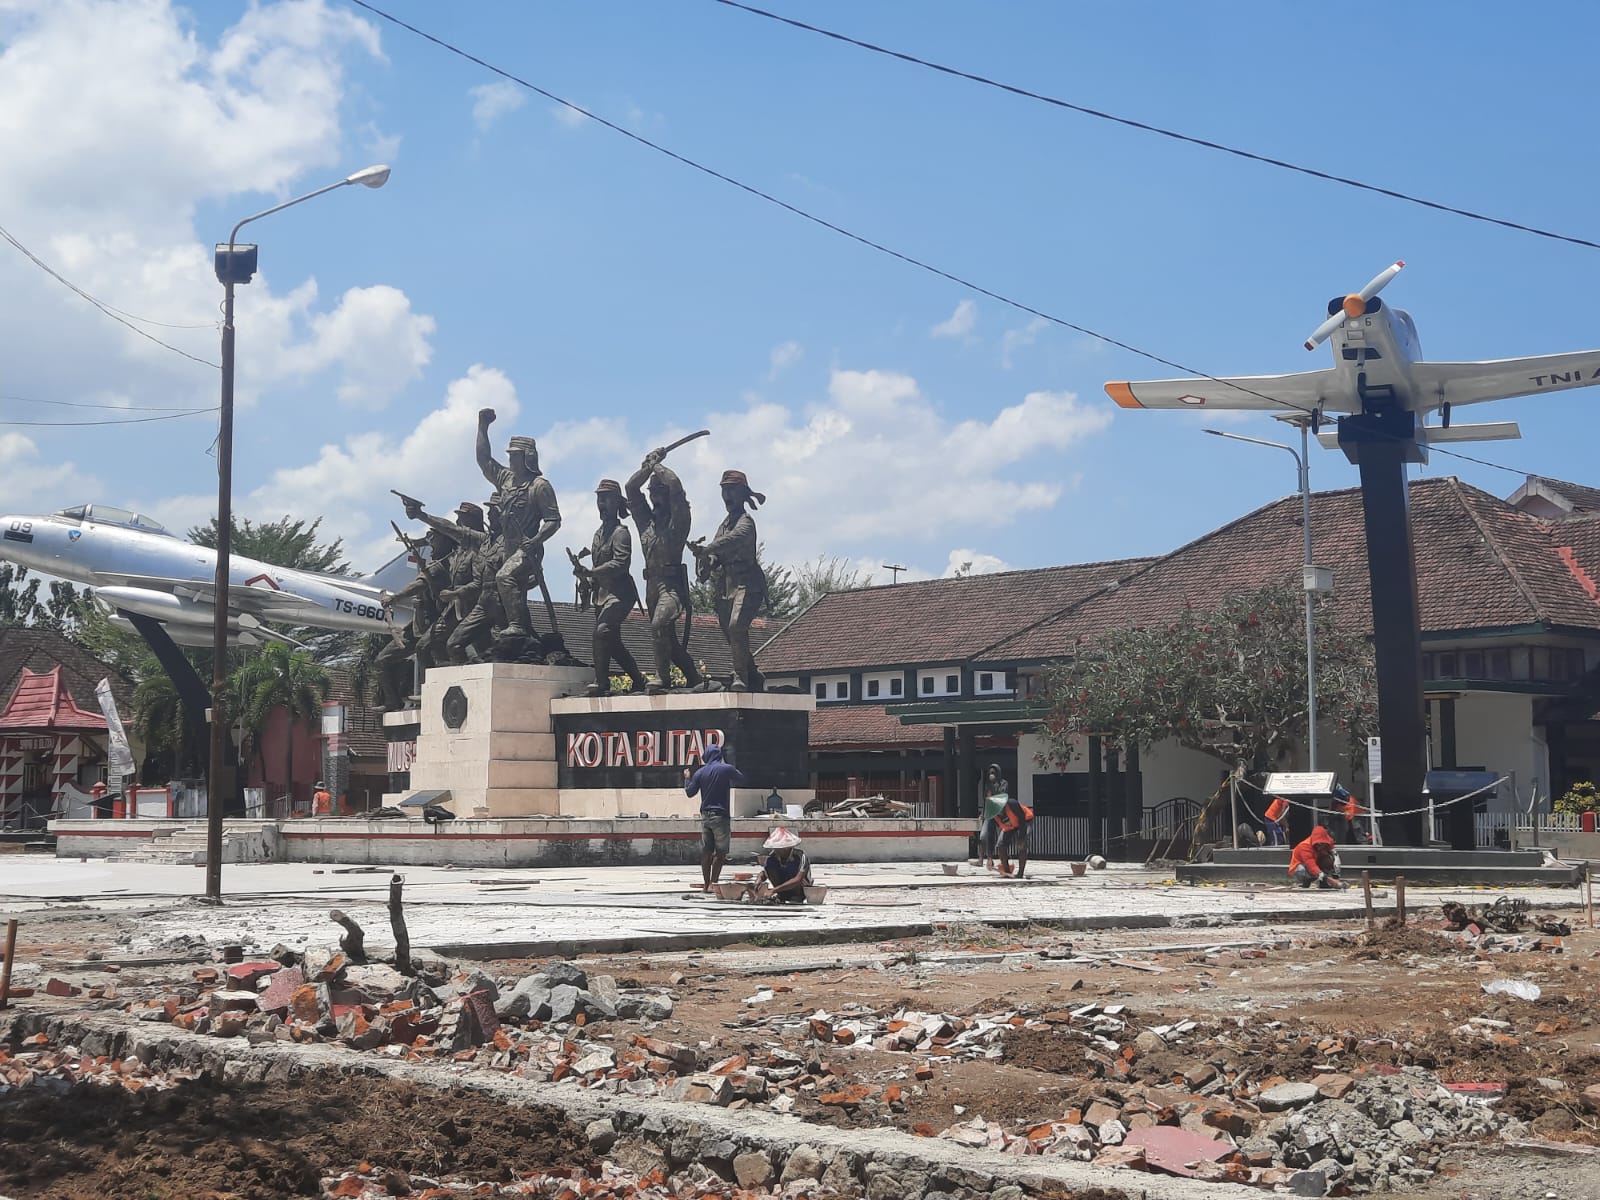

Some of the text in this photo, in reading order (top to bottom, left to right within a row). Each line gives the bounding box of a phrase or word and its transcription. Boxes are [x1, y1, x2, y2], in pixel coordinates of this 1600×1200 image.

[1528, 371, 1582, 387] TNI
[335, 598, 394, 622] TS-860
[566, 732, 634, 767] KOTA
